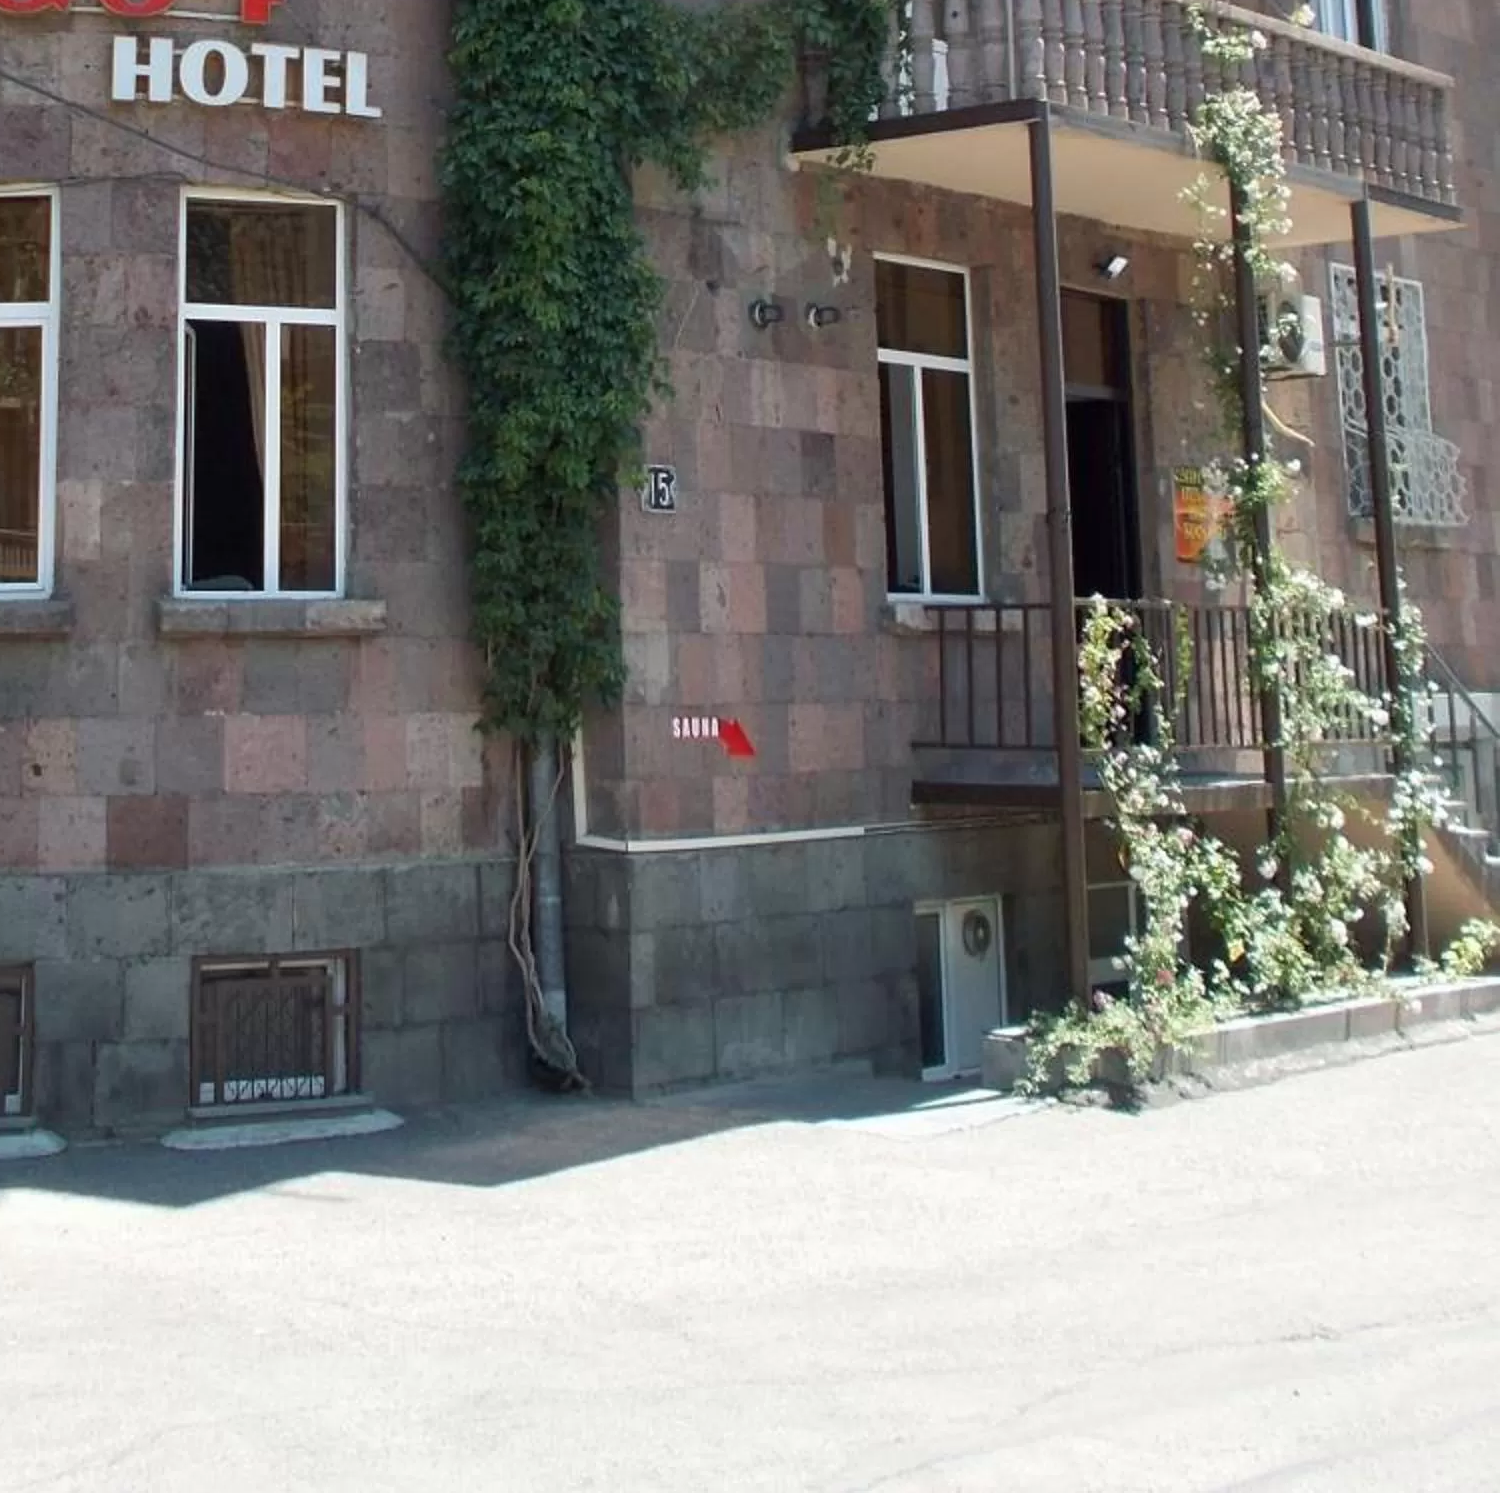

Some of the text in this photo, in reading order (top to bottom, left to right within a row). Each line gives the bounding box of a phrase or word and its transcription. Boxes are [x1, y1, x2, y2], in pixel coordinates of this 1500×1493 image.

[111, 35, 382, 118] HOTEL
[650, 472, 670, 506] 15
[672, 715, 720, 738] SAUNA
